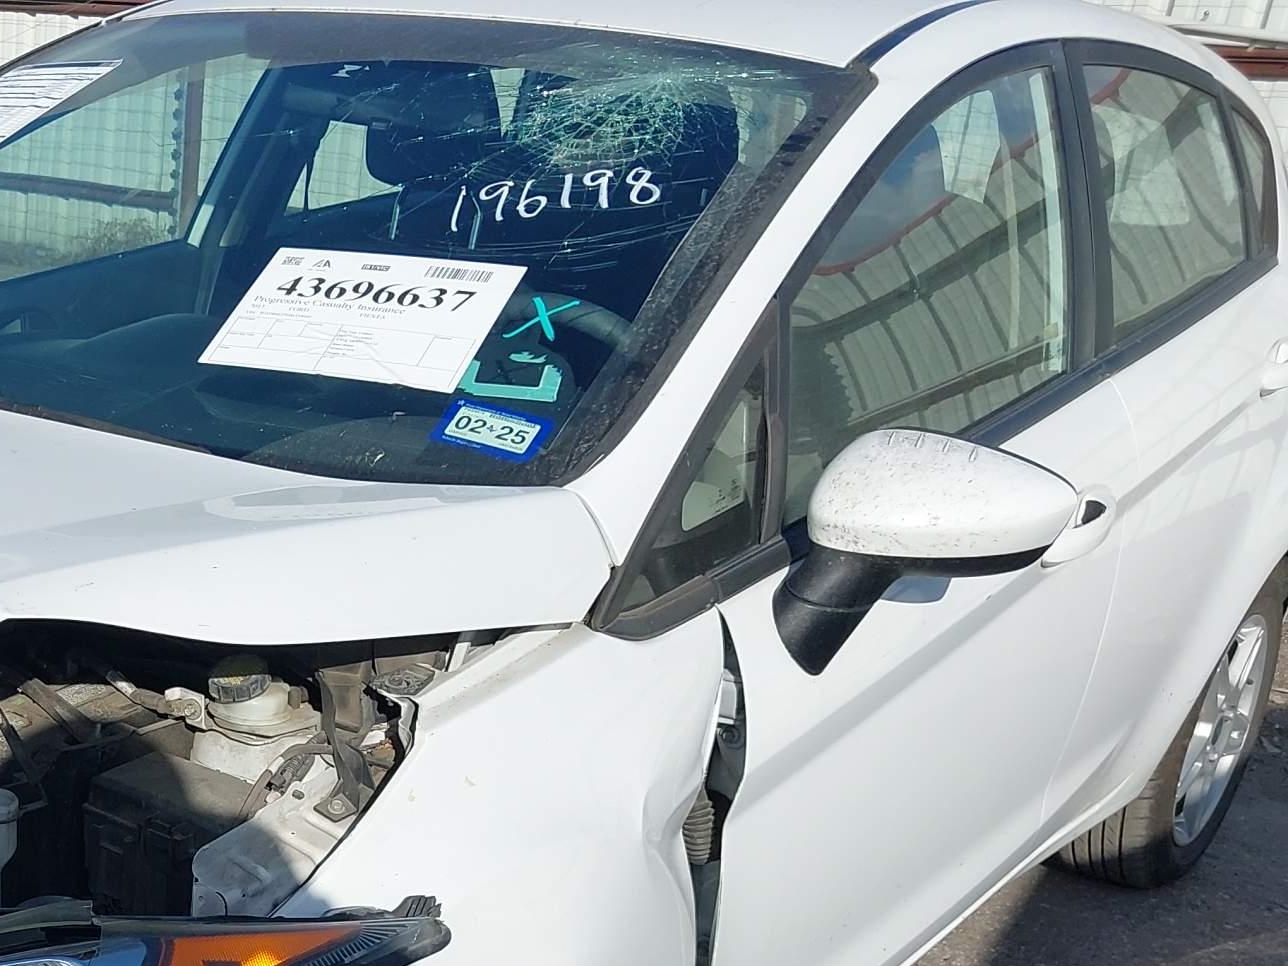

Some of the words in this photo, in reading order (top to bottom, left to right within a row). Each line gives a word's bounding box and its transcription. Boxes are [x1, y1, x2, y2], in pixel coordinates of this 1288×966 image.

[450, 166, 661, 232] 196198
[276, 275, 478, 312] 43696637
[312, 299, 354, 311] Casualty
[357, 303, 406, 314] Insurance
[455, 415, 487, 434] 02
[494, 425, 530, 445] 25
